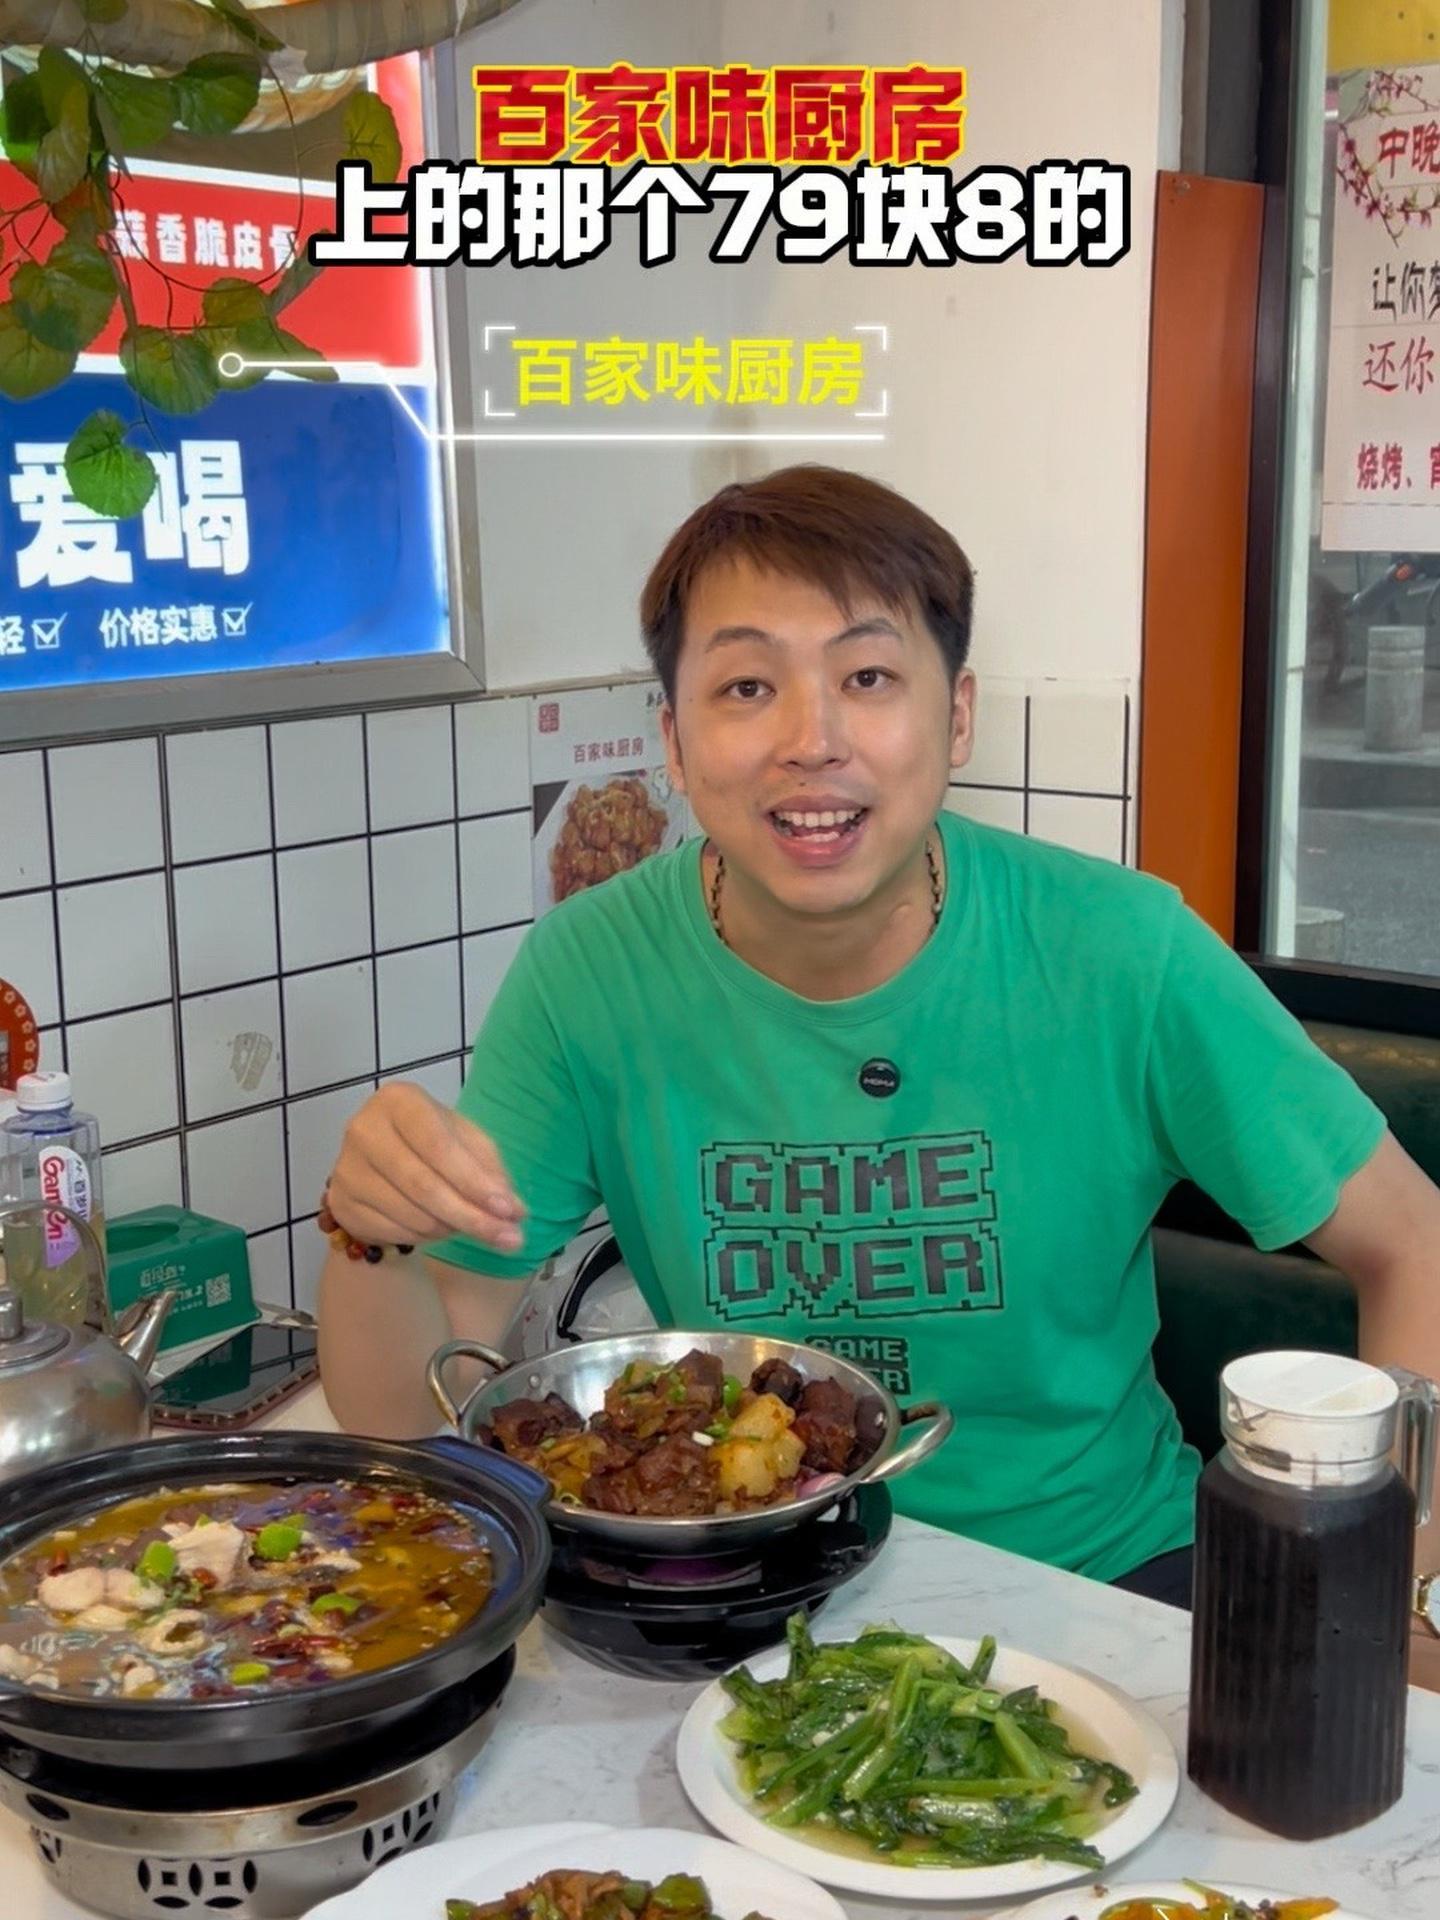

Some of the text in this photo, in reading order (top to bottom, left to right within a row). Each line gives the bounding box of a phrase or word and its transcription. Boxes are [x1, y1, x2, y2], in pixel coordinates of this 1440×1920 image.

[9, 440, 249, 588] 爱喝
[99, 603, 219, 649] 价格实惠
[573, 736, 645, 763] 百家味厨房
[716, 1144, 979, 1213] GAME
[717, 1234, 986, 1301] OVER
